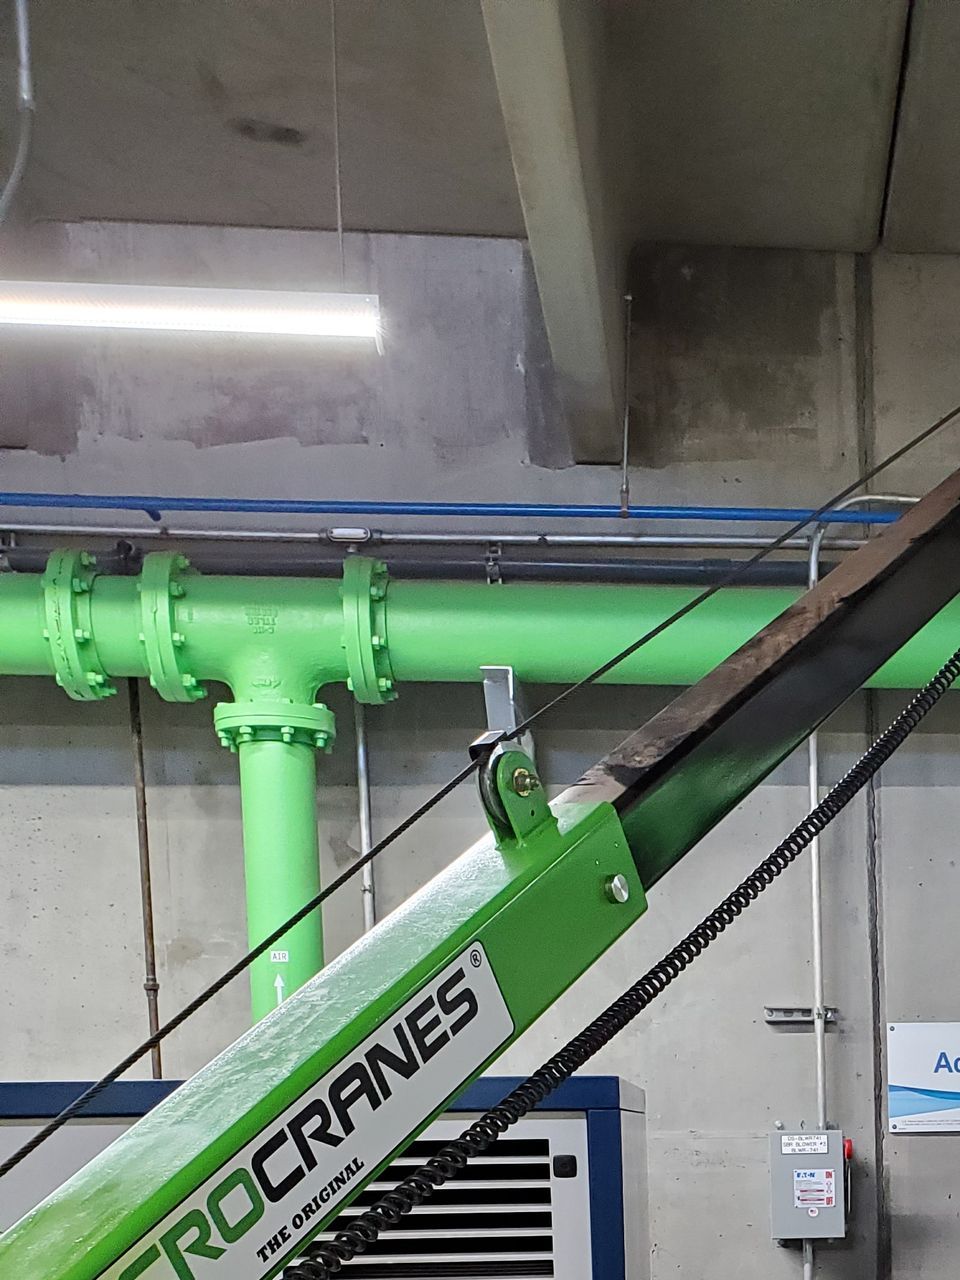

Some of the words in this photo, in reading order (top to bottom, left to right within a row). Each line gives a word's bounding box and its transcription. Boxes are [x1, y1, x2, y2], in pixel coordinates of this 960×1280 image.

[272, 953, 287, 961] AIR
[256, 1225, 292, 1263] THE
[292, 1157, 365, 1230] ORIGINAL
